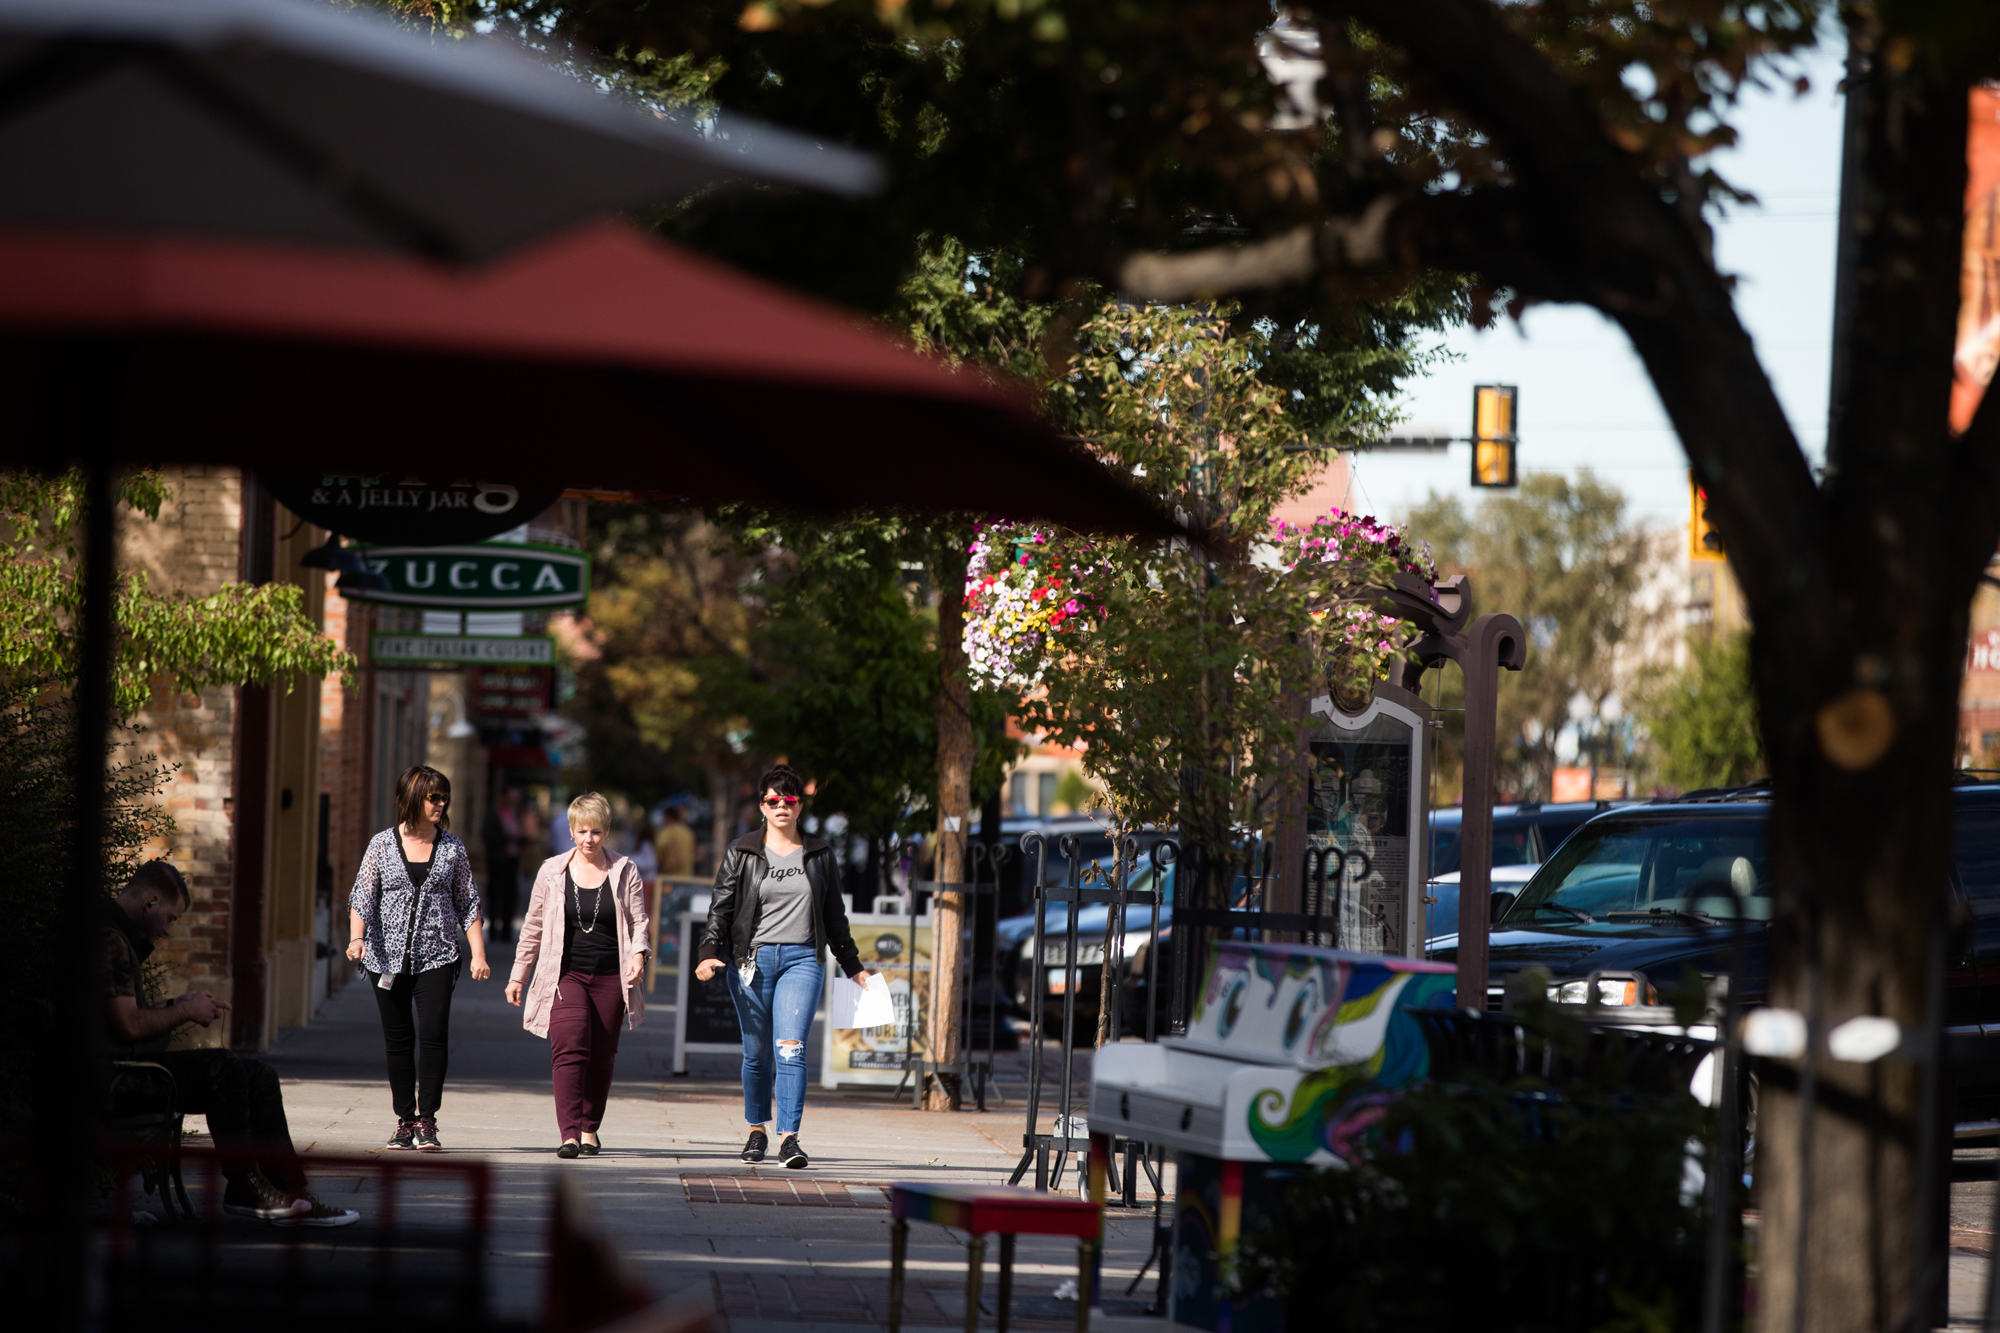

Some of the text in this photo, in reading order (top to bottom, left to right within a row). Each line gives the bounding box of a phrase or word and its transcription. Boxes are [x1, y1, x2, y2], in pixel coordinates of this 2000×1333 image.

[311, 488, 330, 506] &
[337, 489, 353, 505] A
[357, 489, 423, 511] JELLY
[426, 490, 470, 512] JAR
